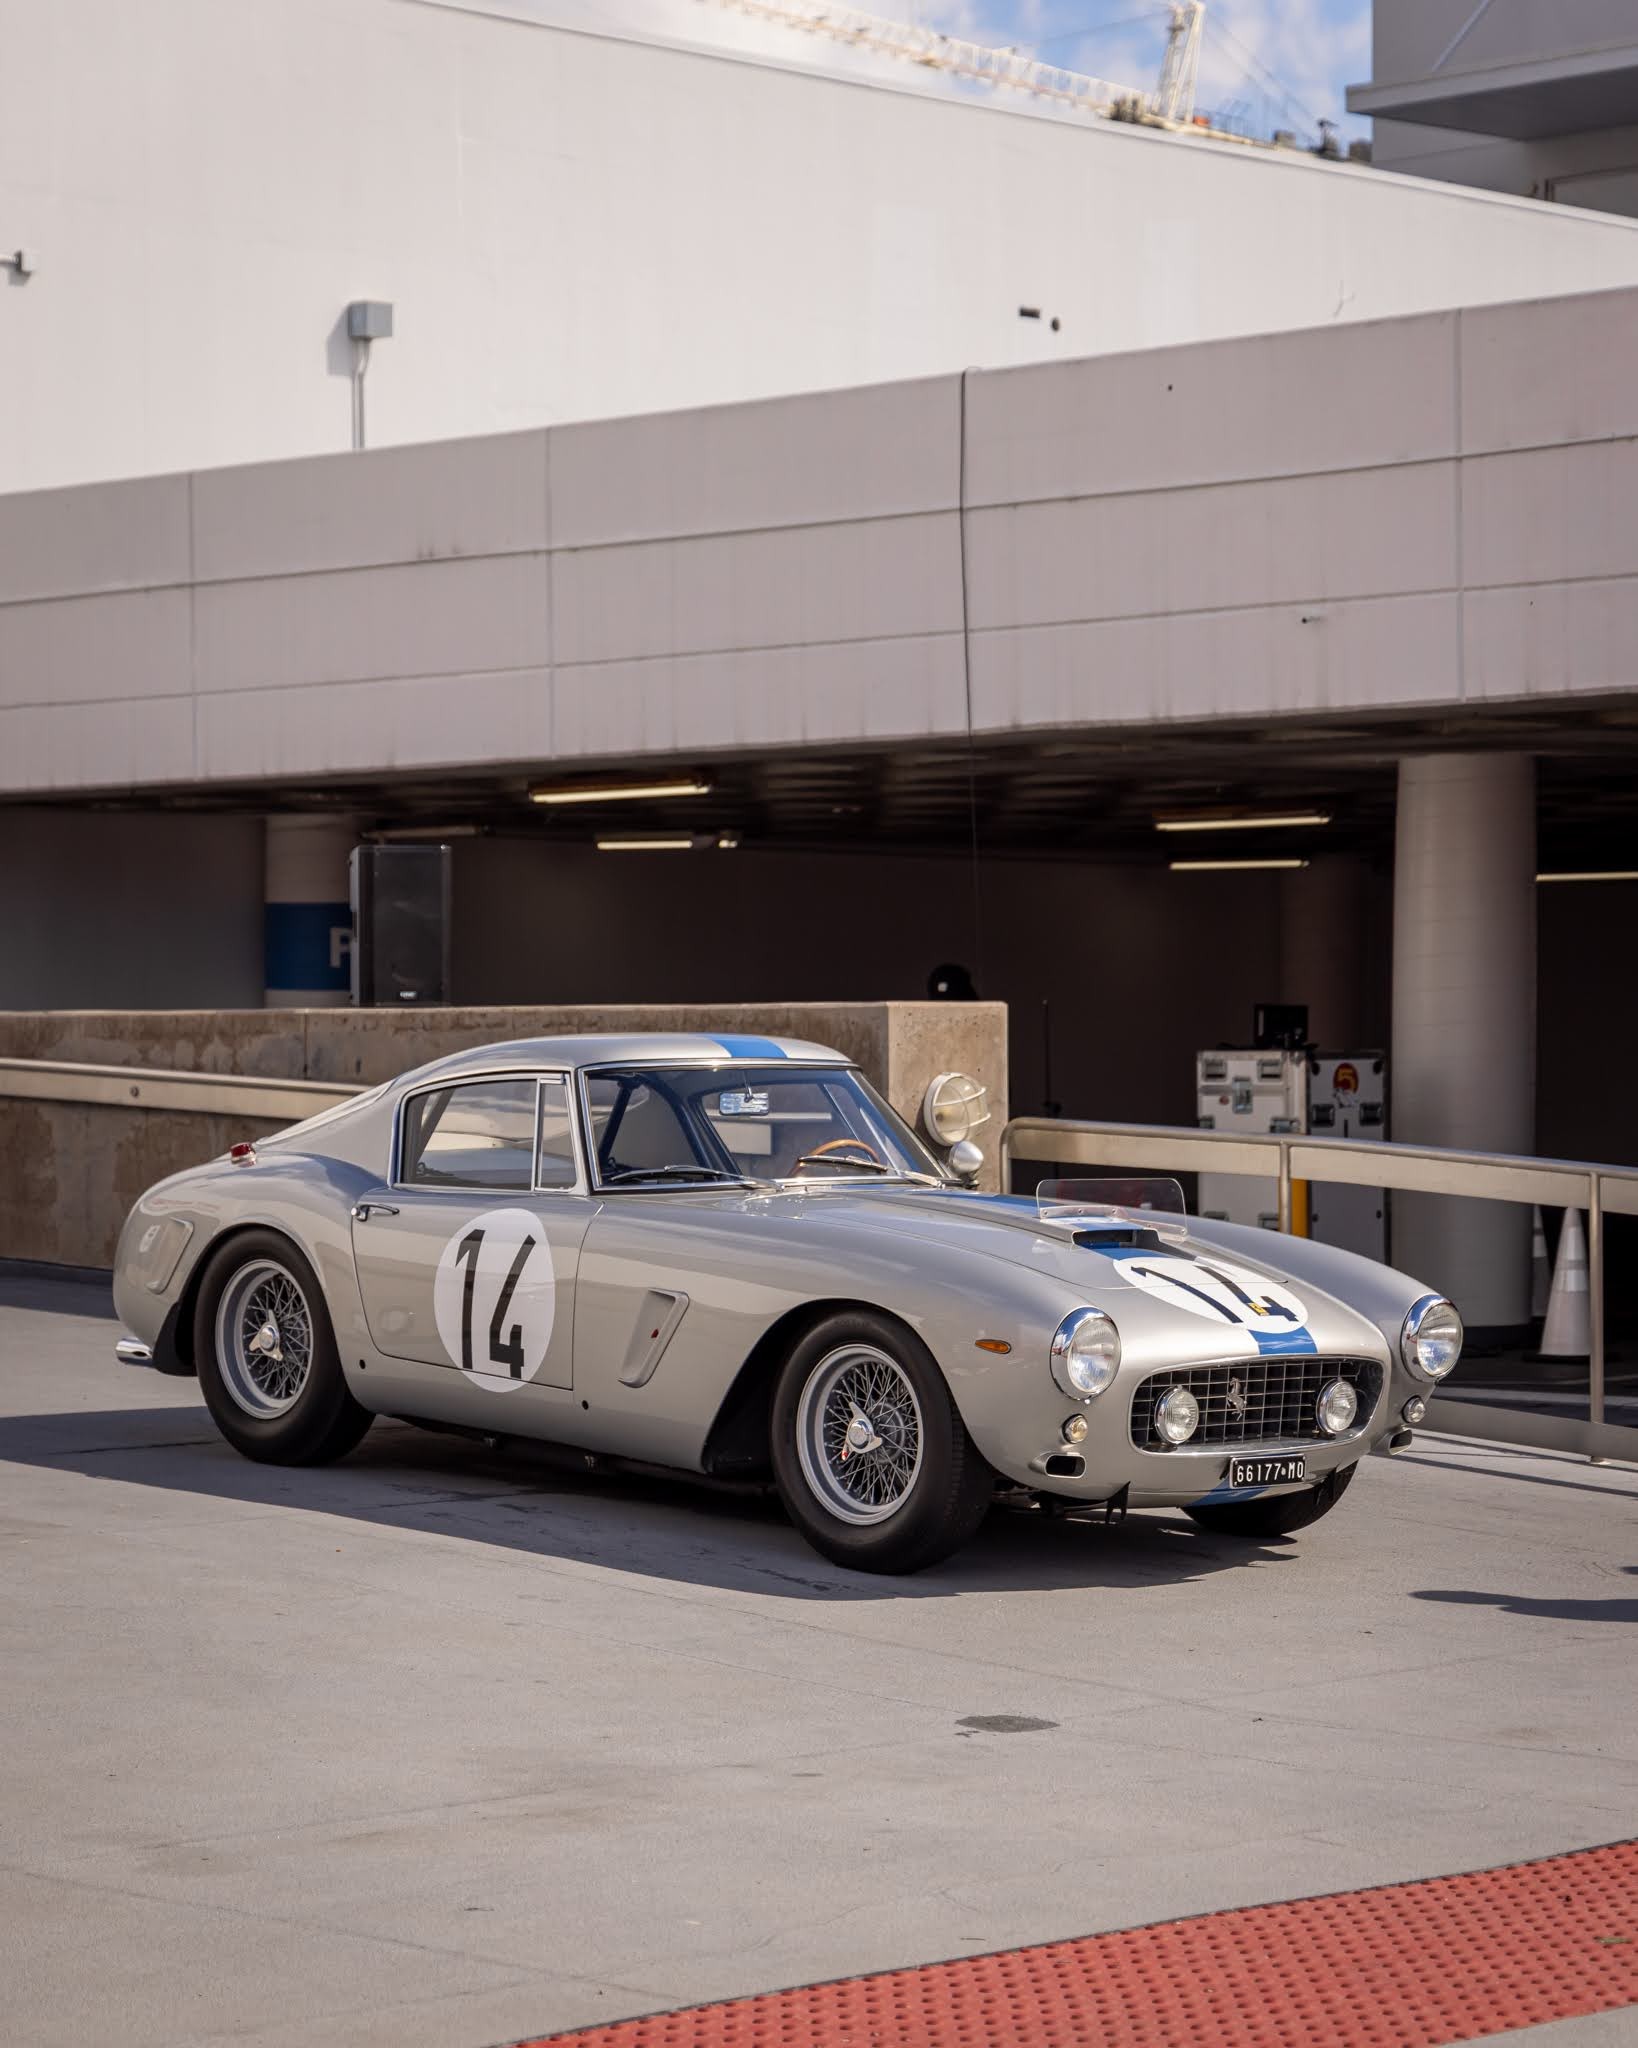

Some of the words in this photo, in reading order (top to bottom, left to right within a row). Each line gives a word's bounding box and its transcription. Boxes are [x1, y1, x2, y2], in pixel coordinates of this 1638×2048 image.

[455, 1228, 537, 1380] 14
[1130, 1265, 1299, 1324] 14
[1236, 1463, 1281, 1483] 66177
[1288, 1461, 1304, 1480] MO
